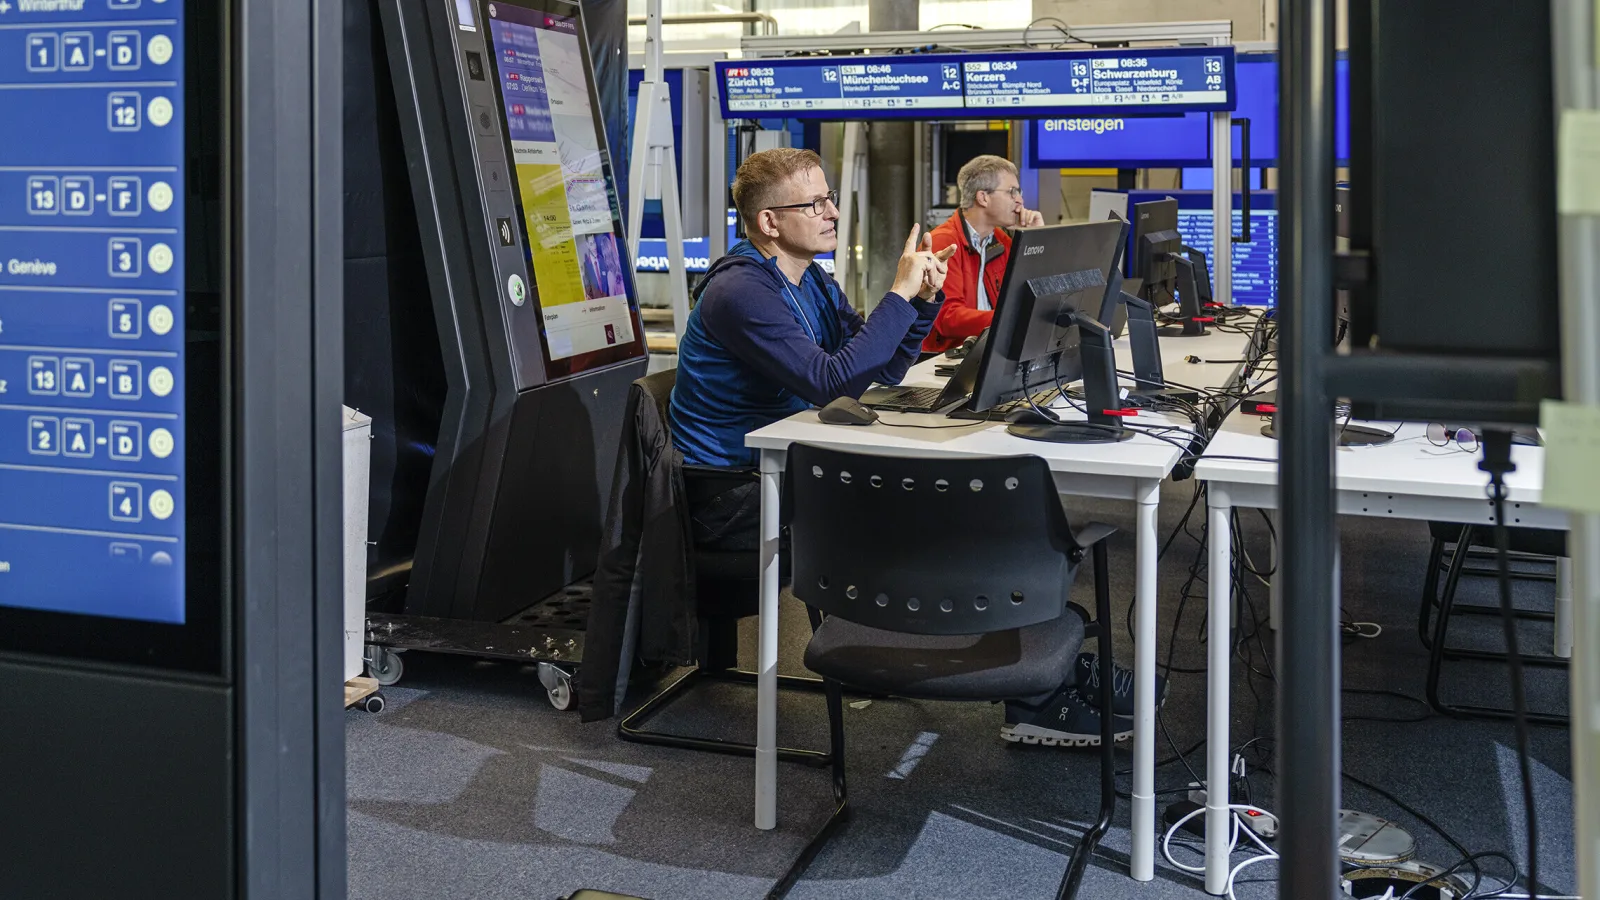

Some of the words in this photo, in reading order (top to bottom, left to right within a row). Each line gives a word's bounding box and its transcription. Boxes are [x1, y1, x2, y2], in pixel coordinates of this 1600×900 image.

[38, 47, 48, 65] 1
[70, 46, 85, 65] A
[117, 46, 132, 64] D
[991, 62, 1017, 70] 08:34
[1120, 58, 1147, 67] 08:36
[1206, 62, 1220, 72] 13
[751, 68, 774, 76] 08:33
[866, 65, 891, 73] 08:46
[943, 68, 957, 78] 12
[1073, 65, 1087, 75] 13
[1093, 68, 1177, 79] Schwarzenburg
[823, 71, 837, 81] 12
[842, 74, 929, 85] Münchenbuchsee
[966, 72, 1006, 82] Kerzers
[1206, 75, 1222, 84] AB
[728, 77, 758, 86] Zürich
[759, 77, 775, 86] HB
[942, 81, 960, 90] A-C
[1071, 78, 1089, 87] D-F
[115, 107, 136, 125] 12
[1044, 118, 1124, 135] einsteigen
[35, 190, 54, 209] 13
[71, 190, 86, 208] D
[119, 191, 131, 209] F
[1023, 245, 1045, 256] Lenovo
[119, 252, 132, 271] 3
[8, 258, 57, 276] Genève
[119, 313, 132, 332] 5
[35, 370, 55, 389] 13
[71, 372, 86, 391] A
[118, 374, 133, 393] B
[38, 430, 51, 449] 2
[71, 432, 86, 451] A
[118, 436, 133, 455] D
[119, 497, 132, 515] 4
